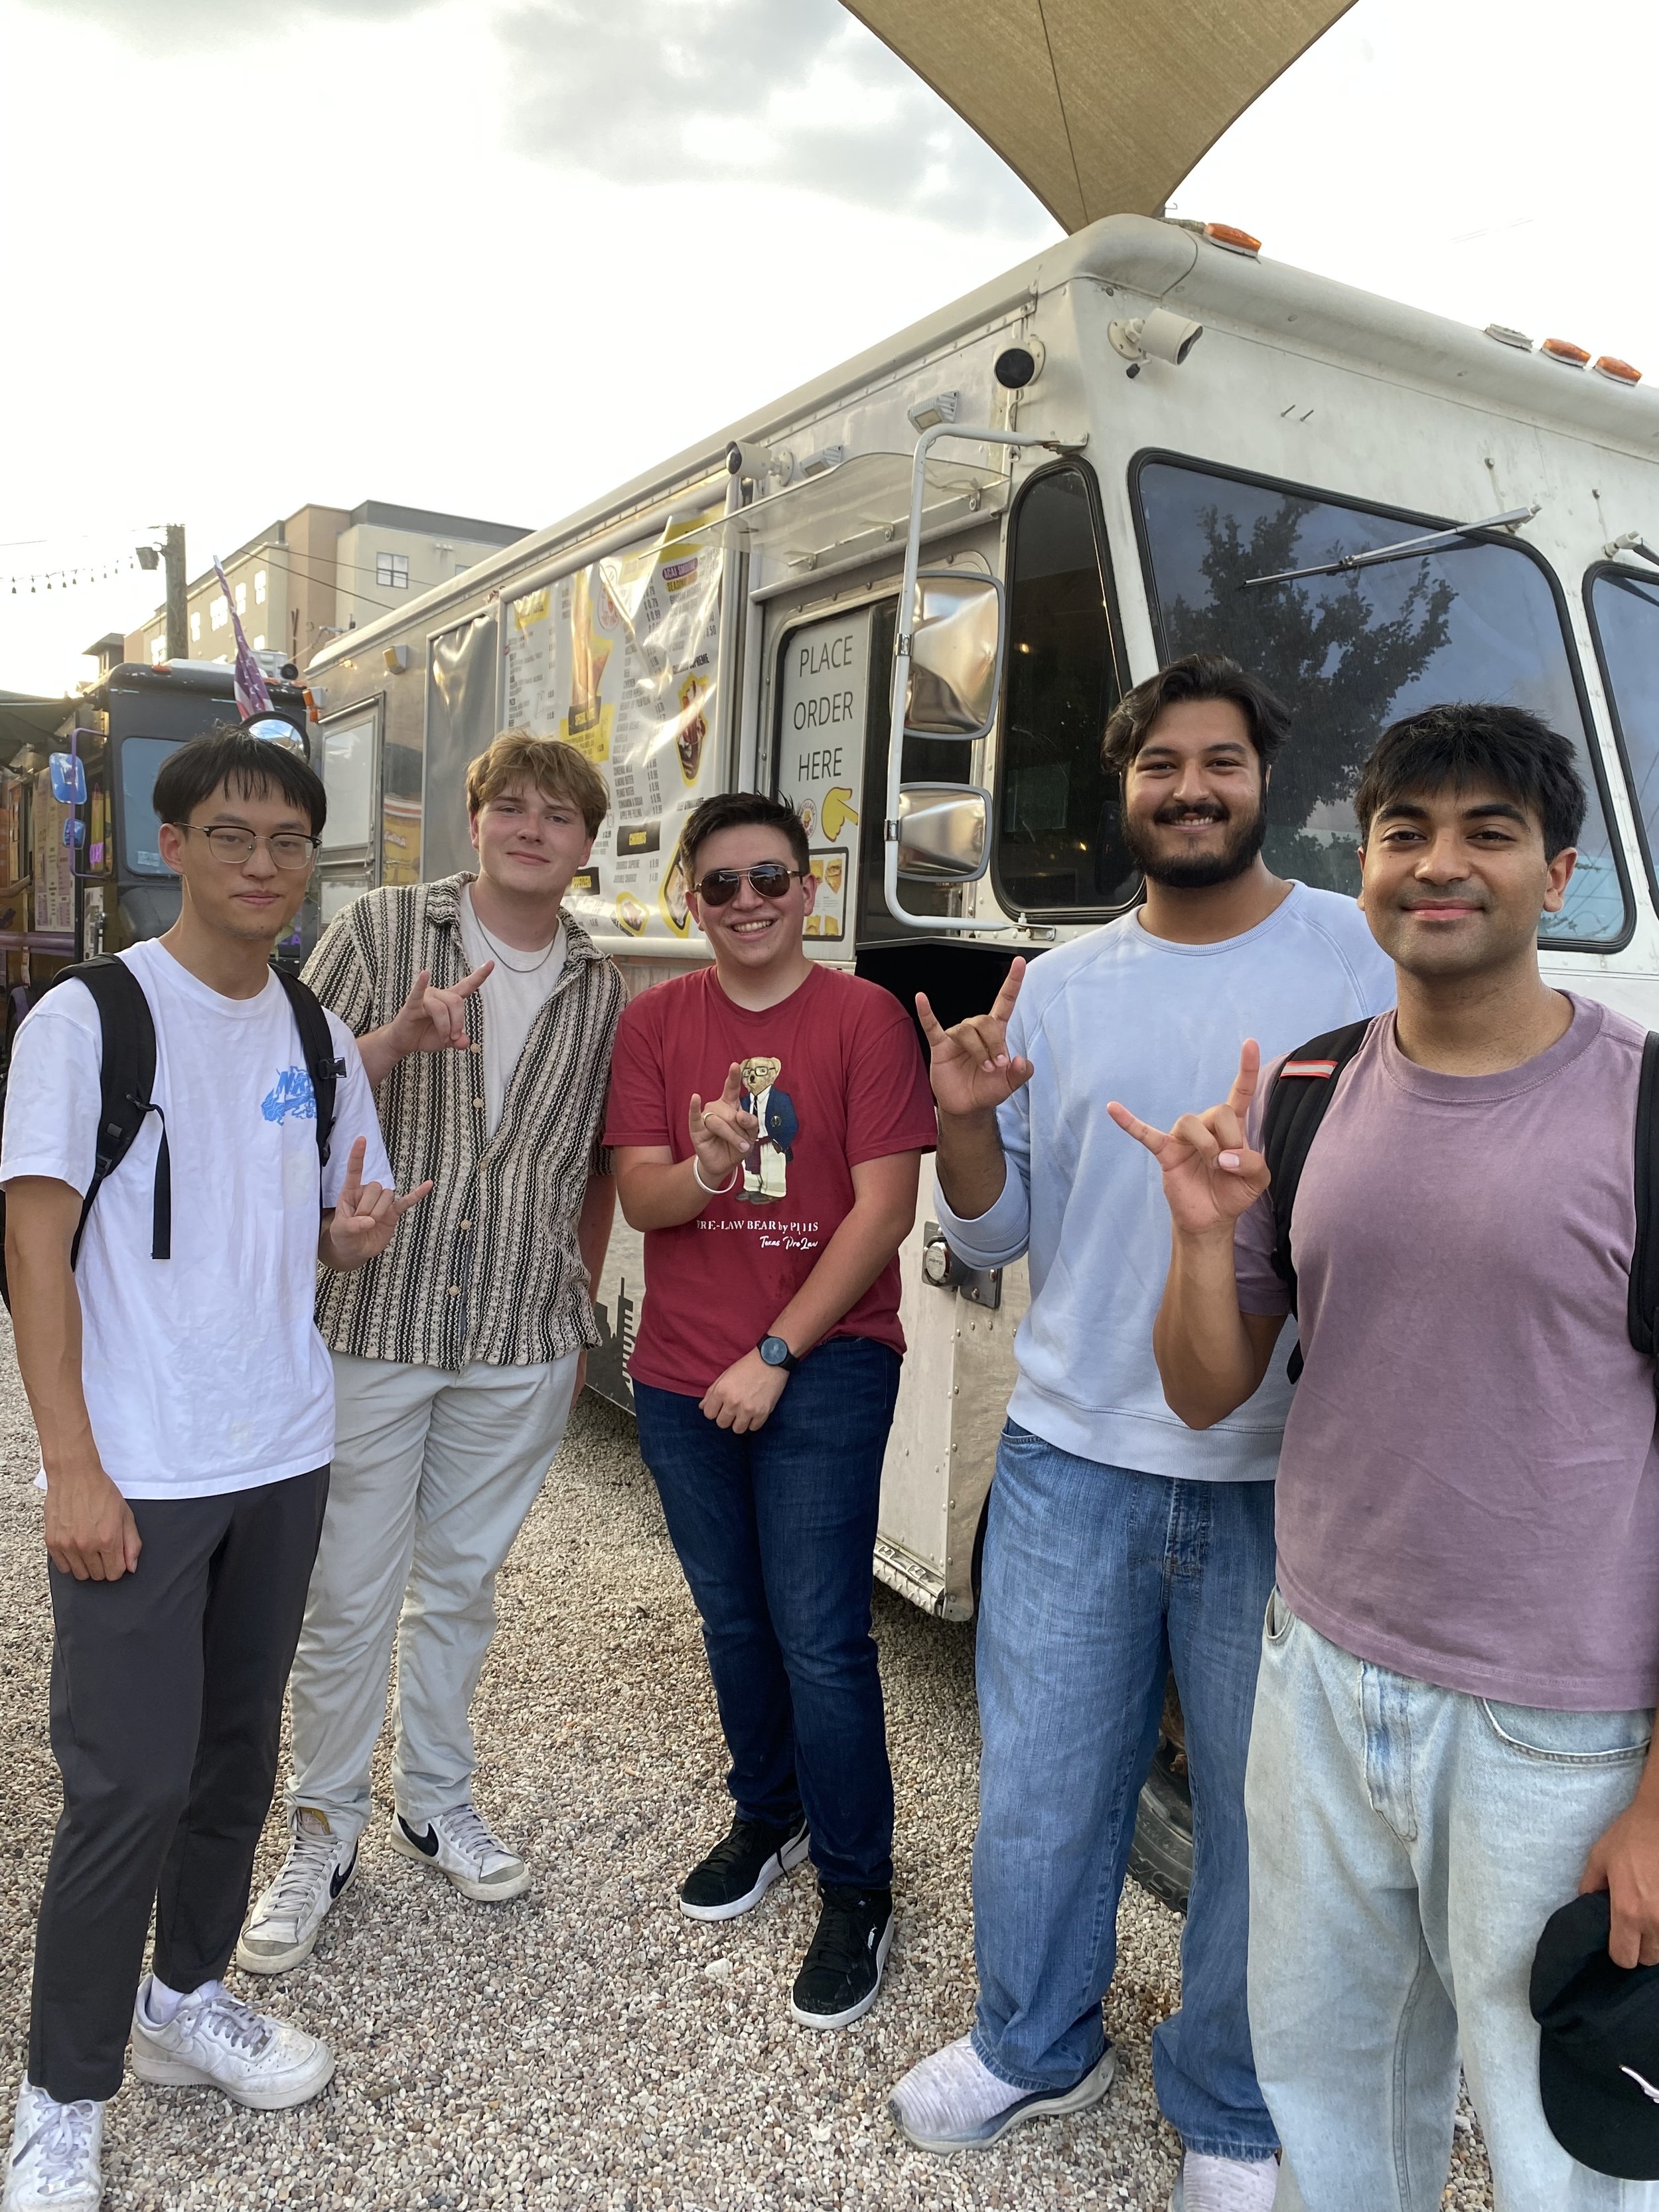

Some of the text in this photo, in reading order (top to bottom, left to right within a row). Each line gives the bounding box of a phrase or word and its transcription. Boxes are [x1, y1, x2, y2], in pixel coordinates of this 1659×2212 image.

[664, 567, 677, 578] ACAI
[800, 635, 853, 678] PLACE
[794, 691, 853, 731] ORDER
[798, 747, 843, 782] HERE
[747, 1221, 776, 1230] BEAR
[778, 1221, 788, 1234] by
[759, 1236, 780, 1248] Texas
